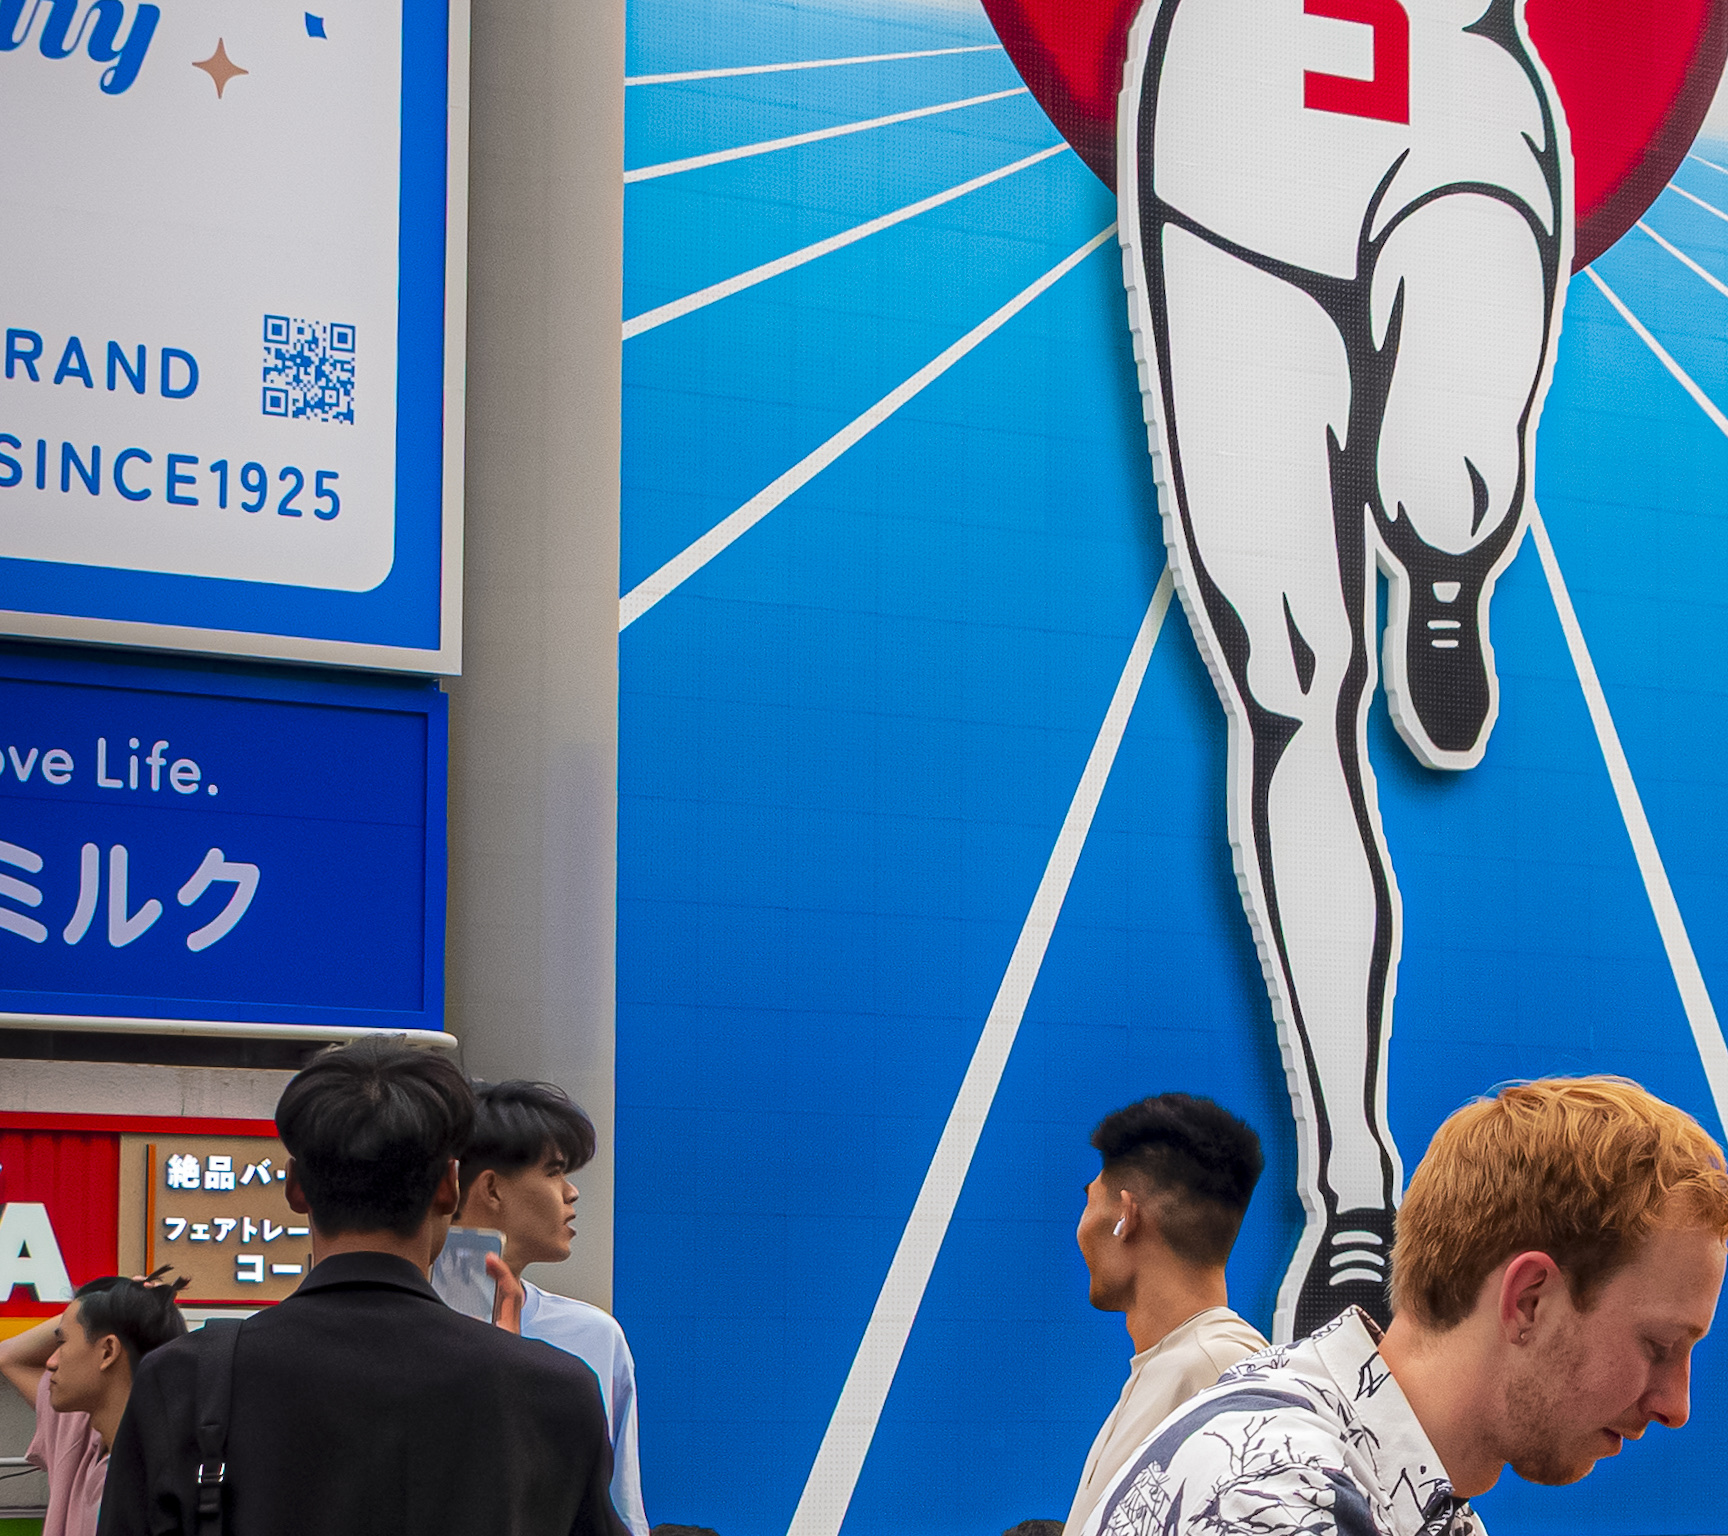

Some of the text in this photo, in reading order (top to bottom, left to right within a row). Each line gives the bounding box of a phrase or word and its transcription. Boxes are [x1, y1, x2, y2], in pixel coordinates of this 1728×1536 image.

[5, 328, 200, 400] RAND
[0, 736, 219, 797] ve Life.
[0, 839, 260, 953] ミルク
[164, 1217, 311, 1243] フェアトレー
[236, 1254, 303, 1284] コー
